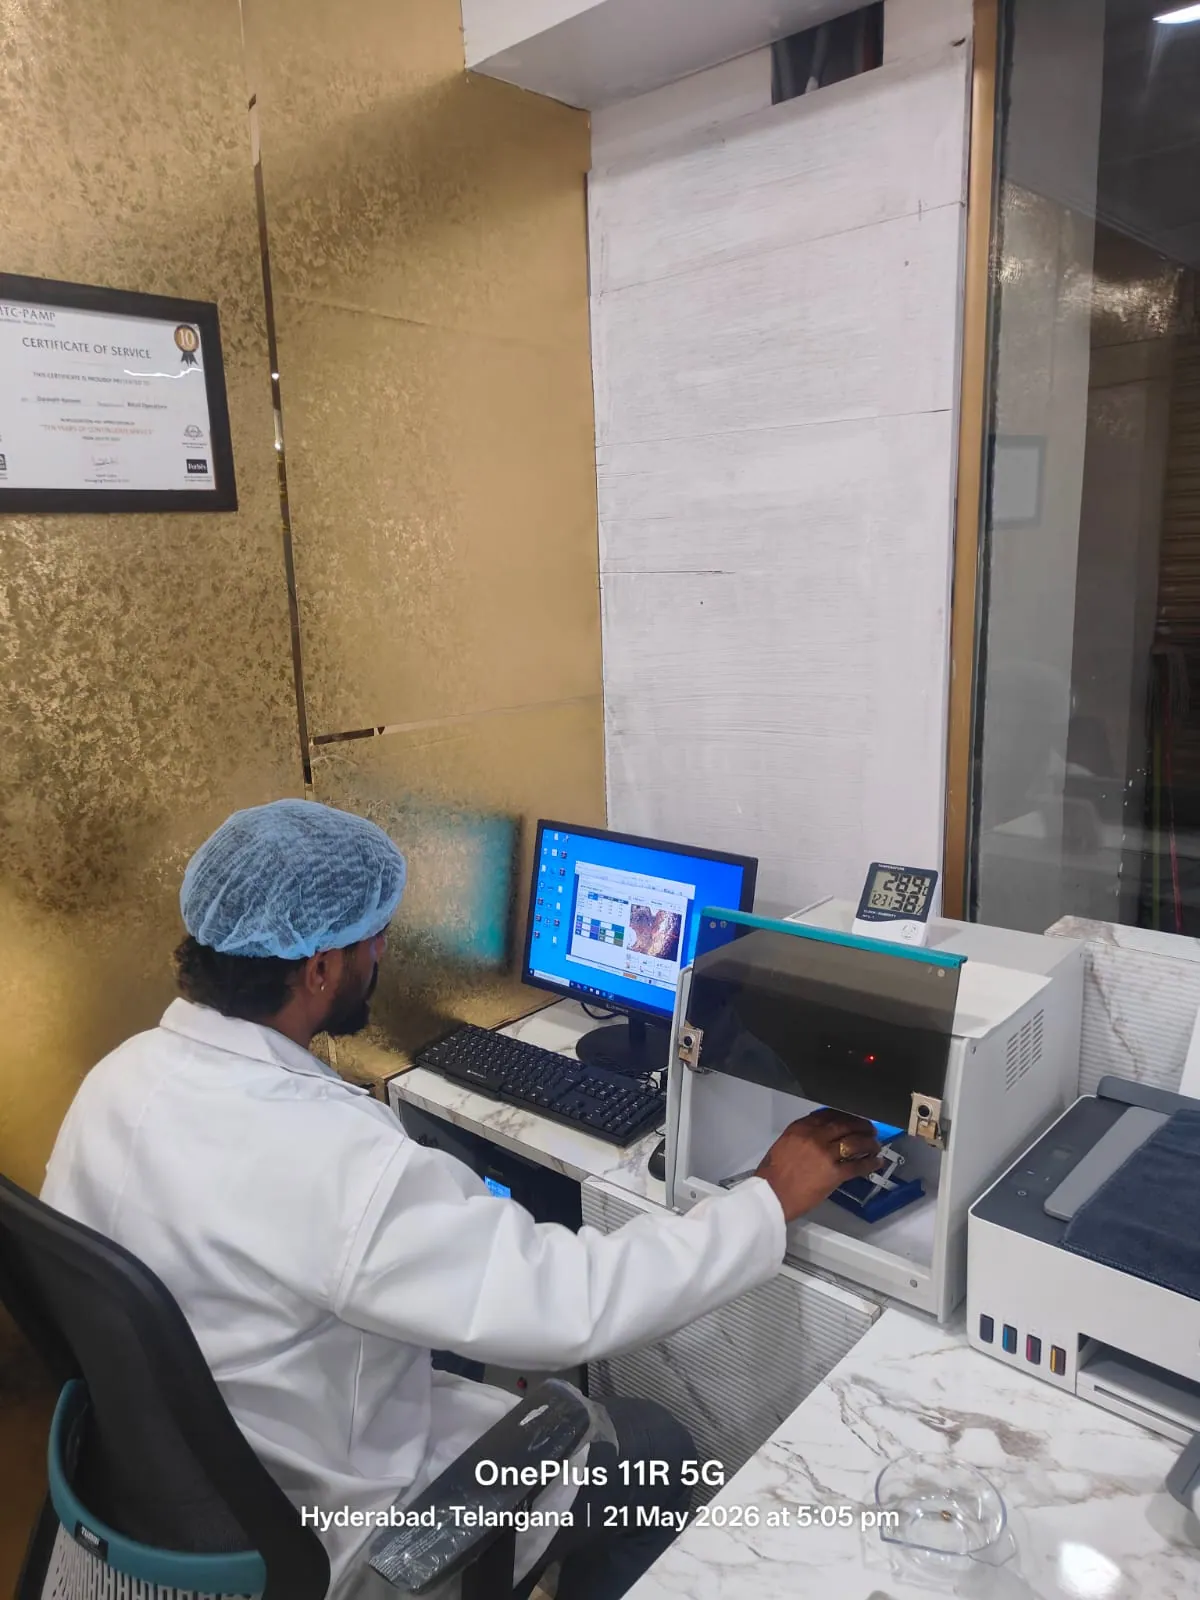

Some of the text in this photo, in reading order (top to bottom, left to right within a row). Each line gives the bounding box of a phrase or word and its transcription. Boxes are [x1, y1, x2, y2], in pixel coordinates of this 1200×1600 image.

[22, 337, 152, 359] CERTIFICATE OF SERVICE
[180, 329, 195, 350] 10
